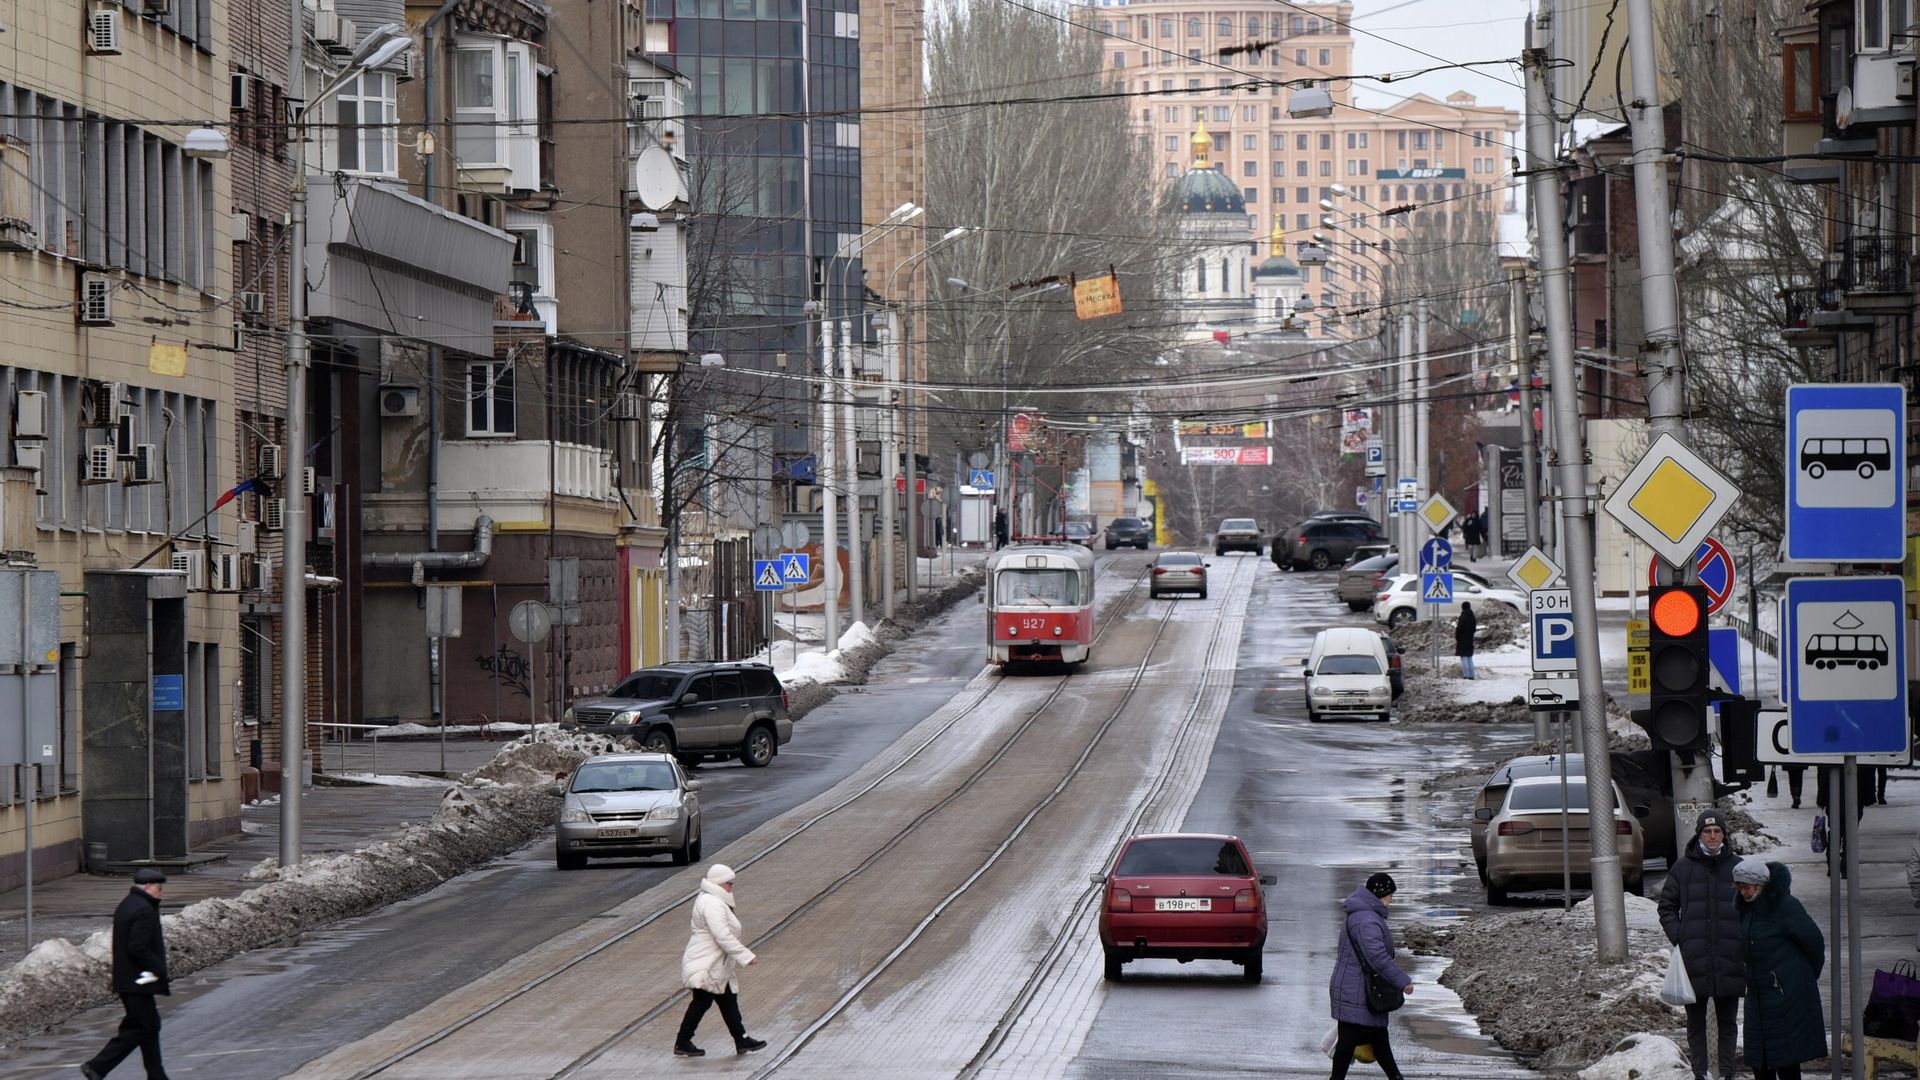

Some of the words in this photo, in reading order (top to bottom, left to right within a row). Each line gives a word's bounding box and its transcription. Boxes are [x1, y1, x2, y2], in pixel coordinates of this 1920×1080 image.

[1213, 448, 1235, 460] 500
[1023, 618, 1046, 629] 927
[1542, 618, 1575, 655] P
